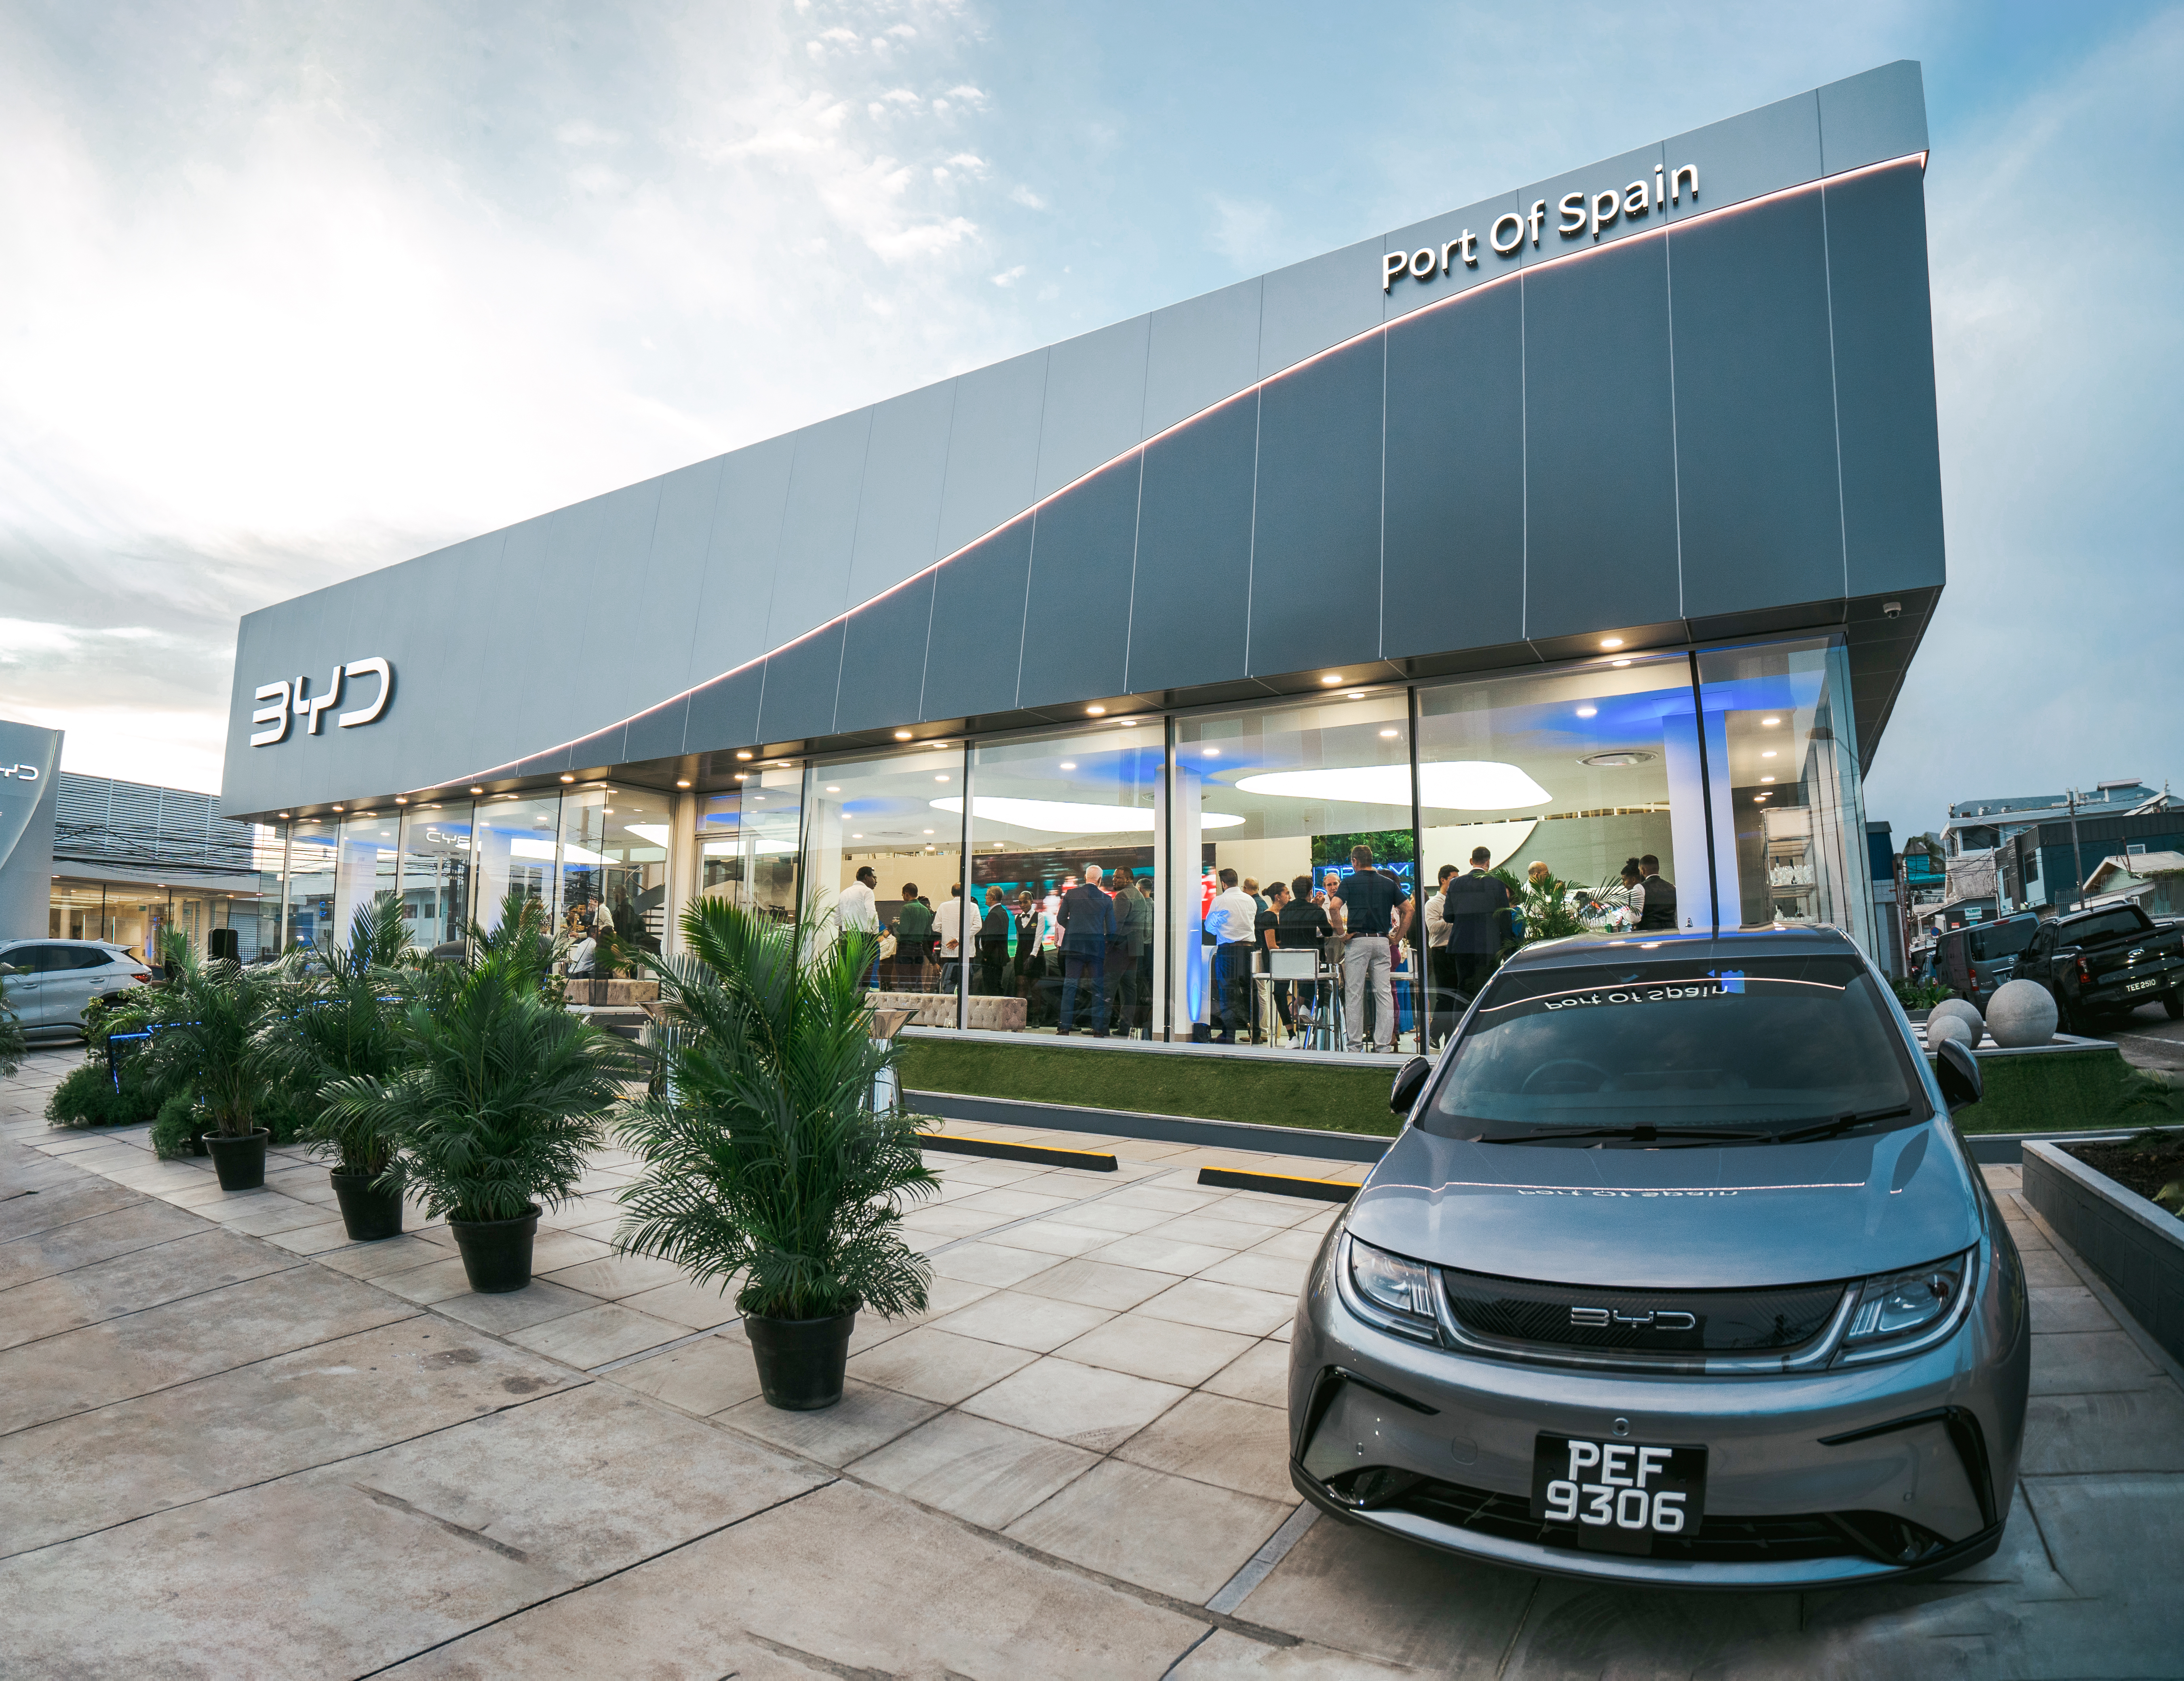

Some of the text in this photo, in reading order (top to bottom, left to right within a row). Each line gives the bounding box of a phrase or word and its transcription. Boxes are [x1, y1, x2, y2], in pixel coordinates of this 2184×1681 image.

[1383, 163, 1699, 293] Port Of Spain
[250, 656, 390, 747] BYD
[0, 762, 39, 780] YD
[1324, 864, 1409, 879] DRM
[1571, 1307, 1695, 1329] BYD
[1568, 1440, 1672, 1488] PEF
[1545, 1479, 1686, 1533] 9306
